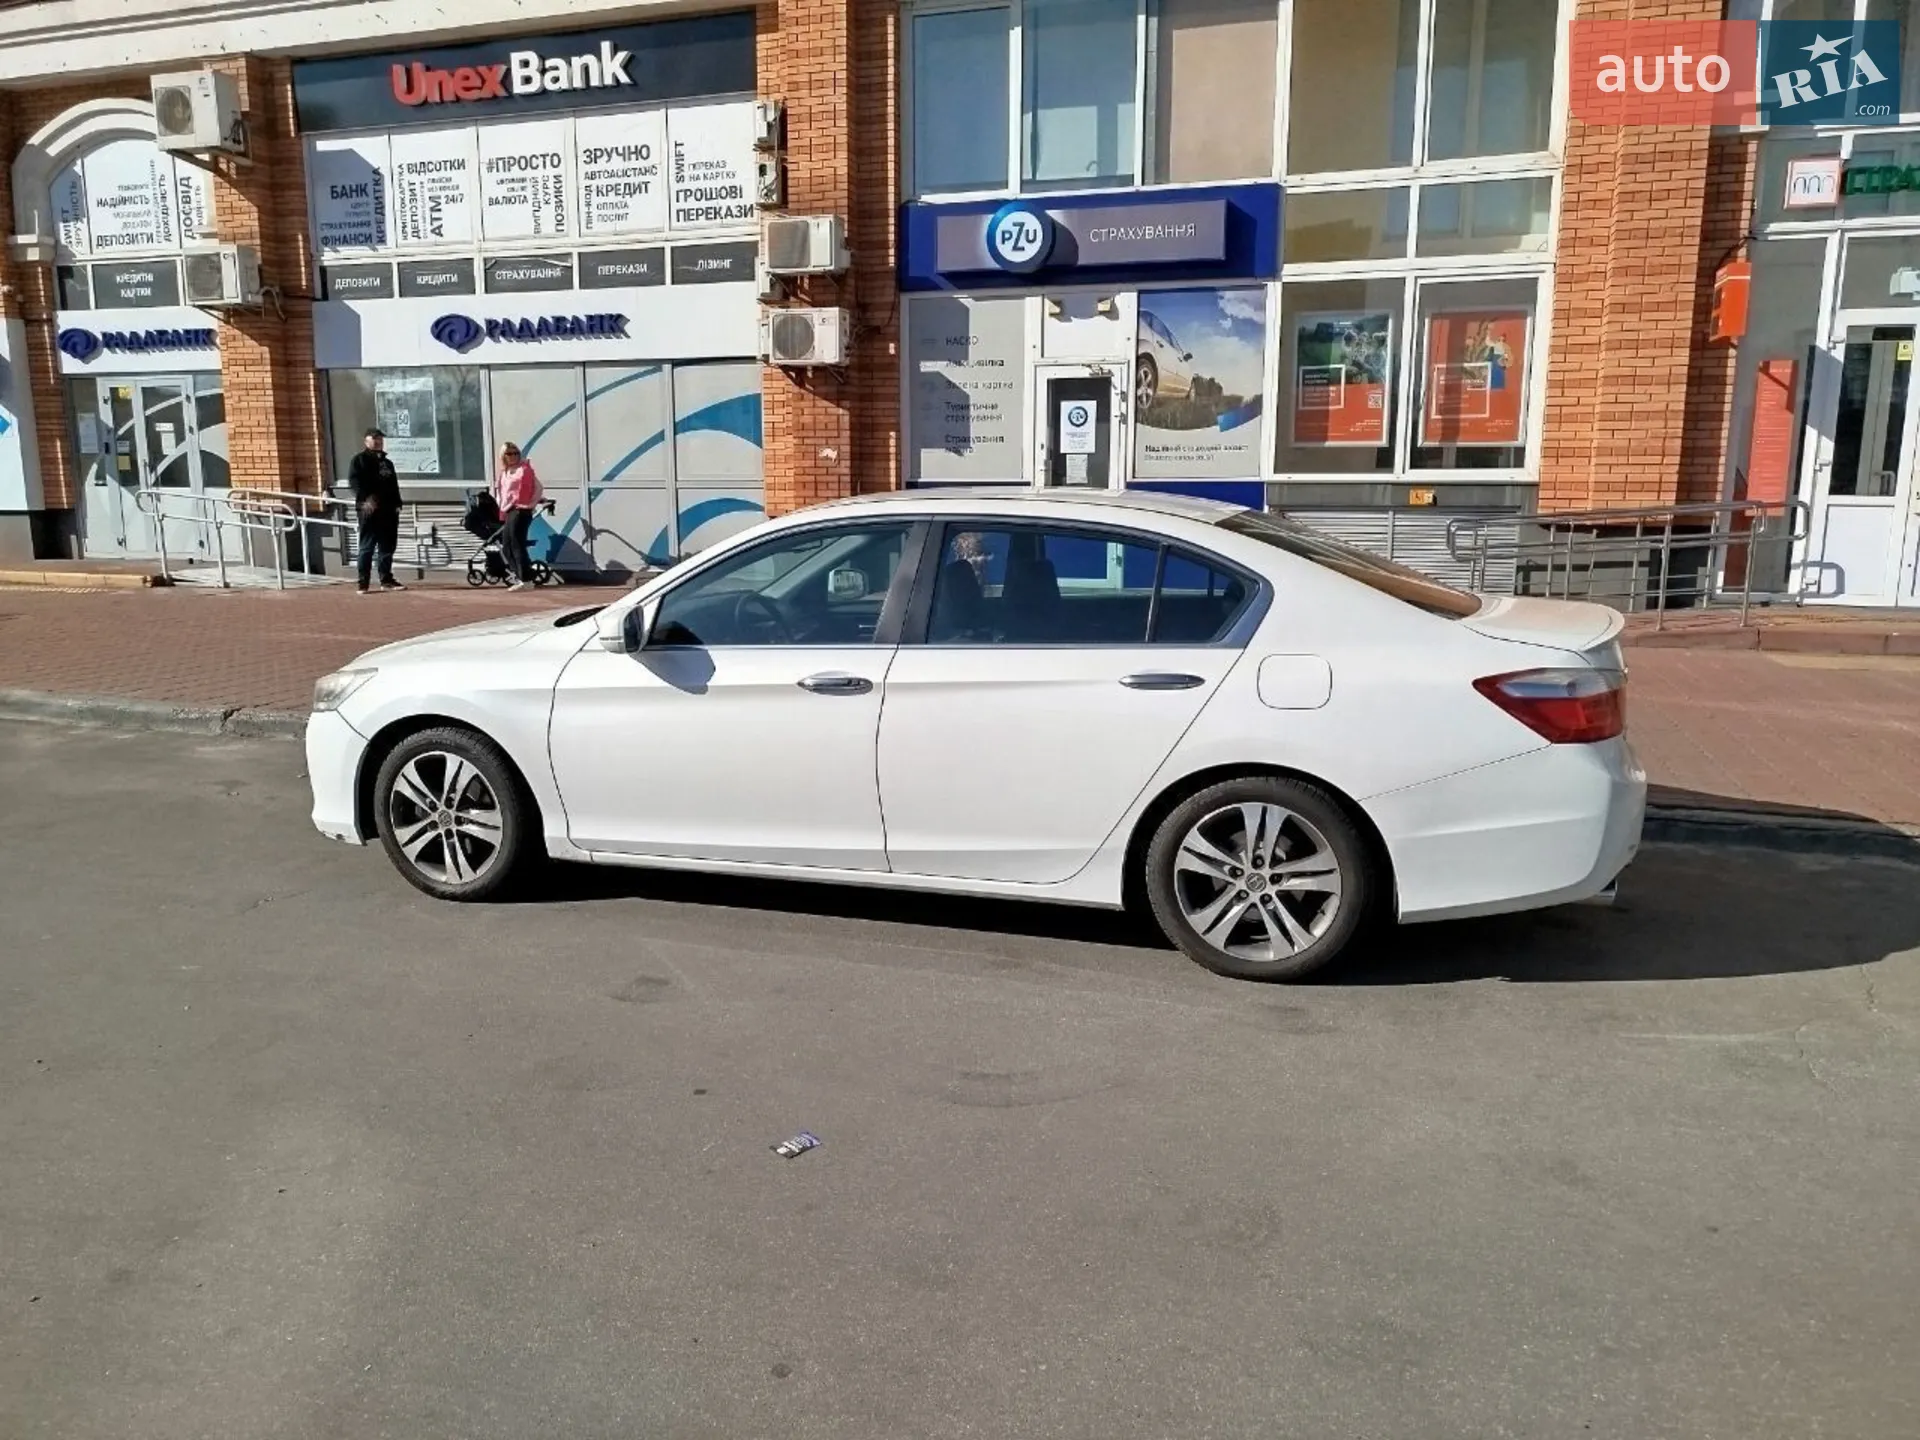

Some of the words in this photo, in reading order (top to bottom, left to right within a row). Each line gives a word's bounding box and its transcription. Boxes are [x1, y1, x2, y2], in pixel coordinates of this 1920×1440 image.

[392, 40, 635, 106] UnexBank
[486, 152, 561, 173] #ПРОСТО
[583, 144, 651, 165] ЗРУЧНО
[675, 141, 685, 184] SWIFT
[407, 158, 466, 176] ВІДСОТКИ
[688, 160, 727, 172] ПЕРЕКАЗ
[689, 174, 701, 182] НА
[703, 171, 737, 181] КАРТКУ
[330, 182, 370, 200] БАНК
[542, 174, 552, 205] КУРС
[596, 181, 651, 199] КРЕДИТ
[676, 185, 744, 203] ГРОШОВІ
[96, 194, 151, 208] НАДІЙНІСТЬ
[180, 176, 197, 240] ДОСВІД
[372, 166, 386, 244] КРЕДИТКА
[488, 194, 529, 206] ВАЛЮТА
[553, 174, 565, 233] ПОЗИКИ
[584, 184, 593, 230] ПІН-КОД
[408, 180, 422, 240] ДЕПОЗИТ
[676, 204, 754, 222] ПЕРЕКАЗИ
[96, 232, 154, 248] ДЕПОЗИТИ
[320, 232, 373, 246] ФІНАНСИ
[1001, 221, 1038, 252] PZU
[1089, 223, 1196, 243] СТРАХУВАННЯ
[495, 267, 562, 280] СТРАХУВАННЯ
[598, 263, 648, 275] ПЕРЕКАЗИ
[696, 258, 733, 271] ЛІЗИНГ
[116, 272, 154, 284] КРЕДИТНІ
[335, 277, 381, 290] ДЕПОЗИТИ
[416, 273, 459, 285] КРЕДИТИ
[120, 287, 152, 298] КАРТКИ
[485, 313, 626, 340] РАДАБАНК
[100, 328, 216, 351] РАДАБАНК
